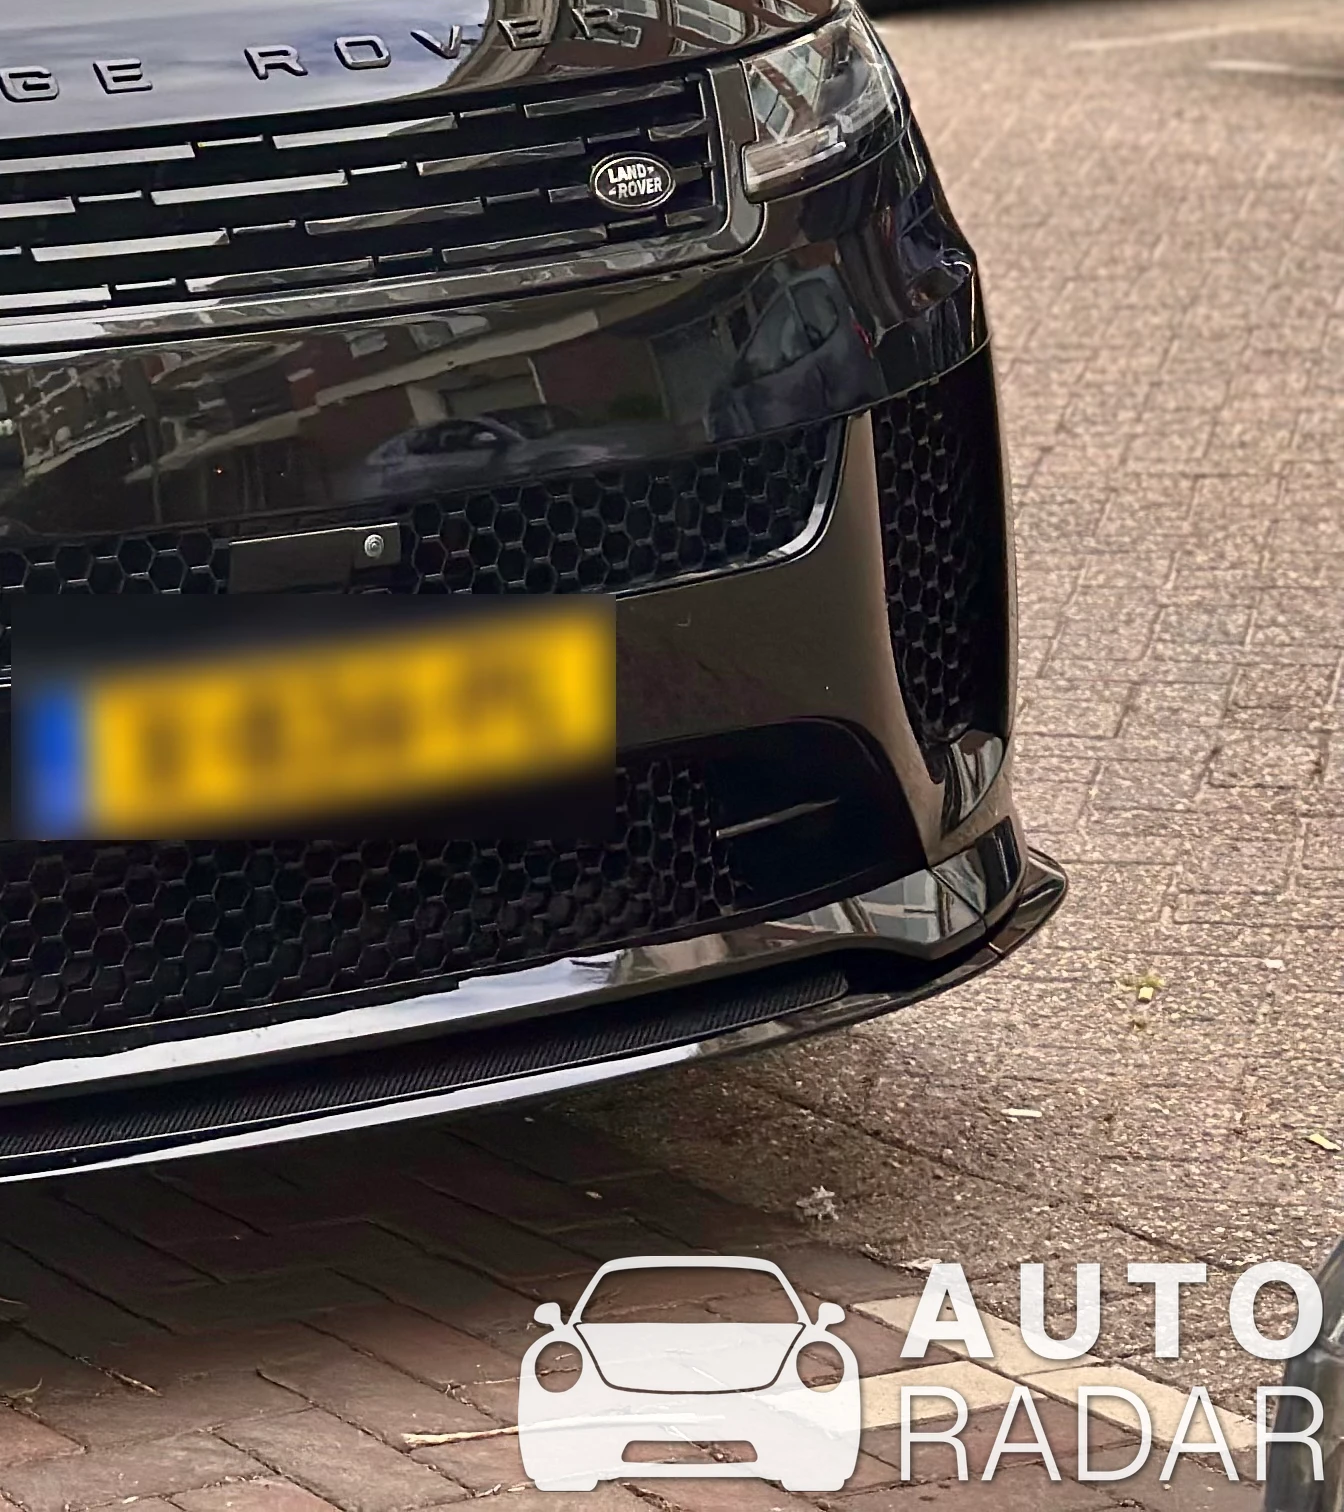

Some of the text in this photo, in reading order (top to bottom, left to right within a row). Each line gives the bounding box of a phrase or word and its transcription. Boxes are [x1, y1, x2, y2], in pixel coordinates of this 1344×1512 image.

[244, 4, 626, 80] ROVER
[607, 163, 647, 184] LAND
[617, 176, 663, 200] ROVER
